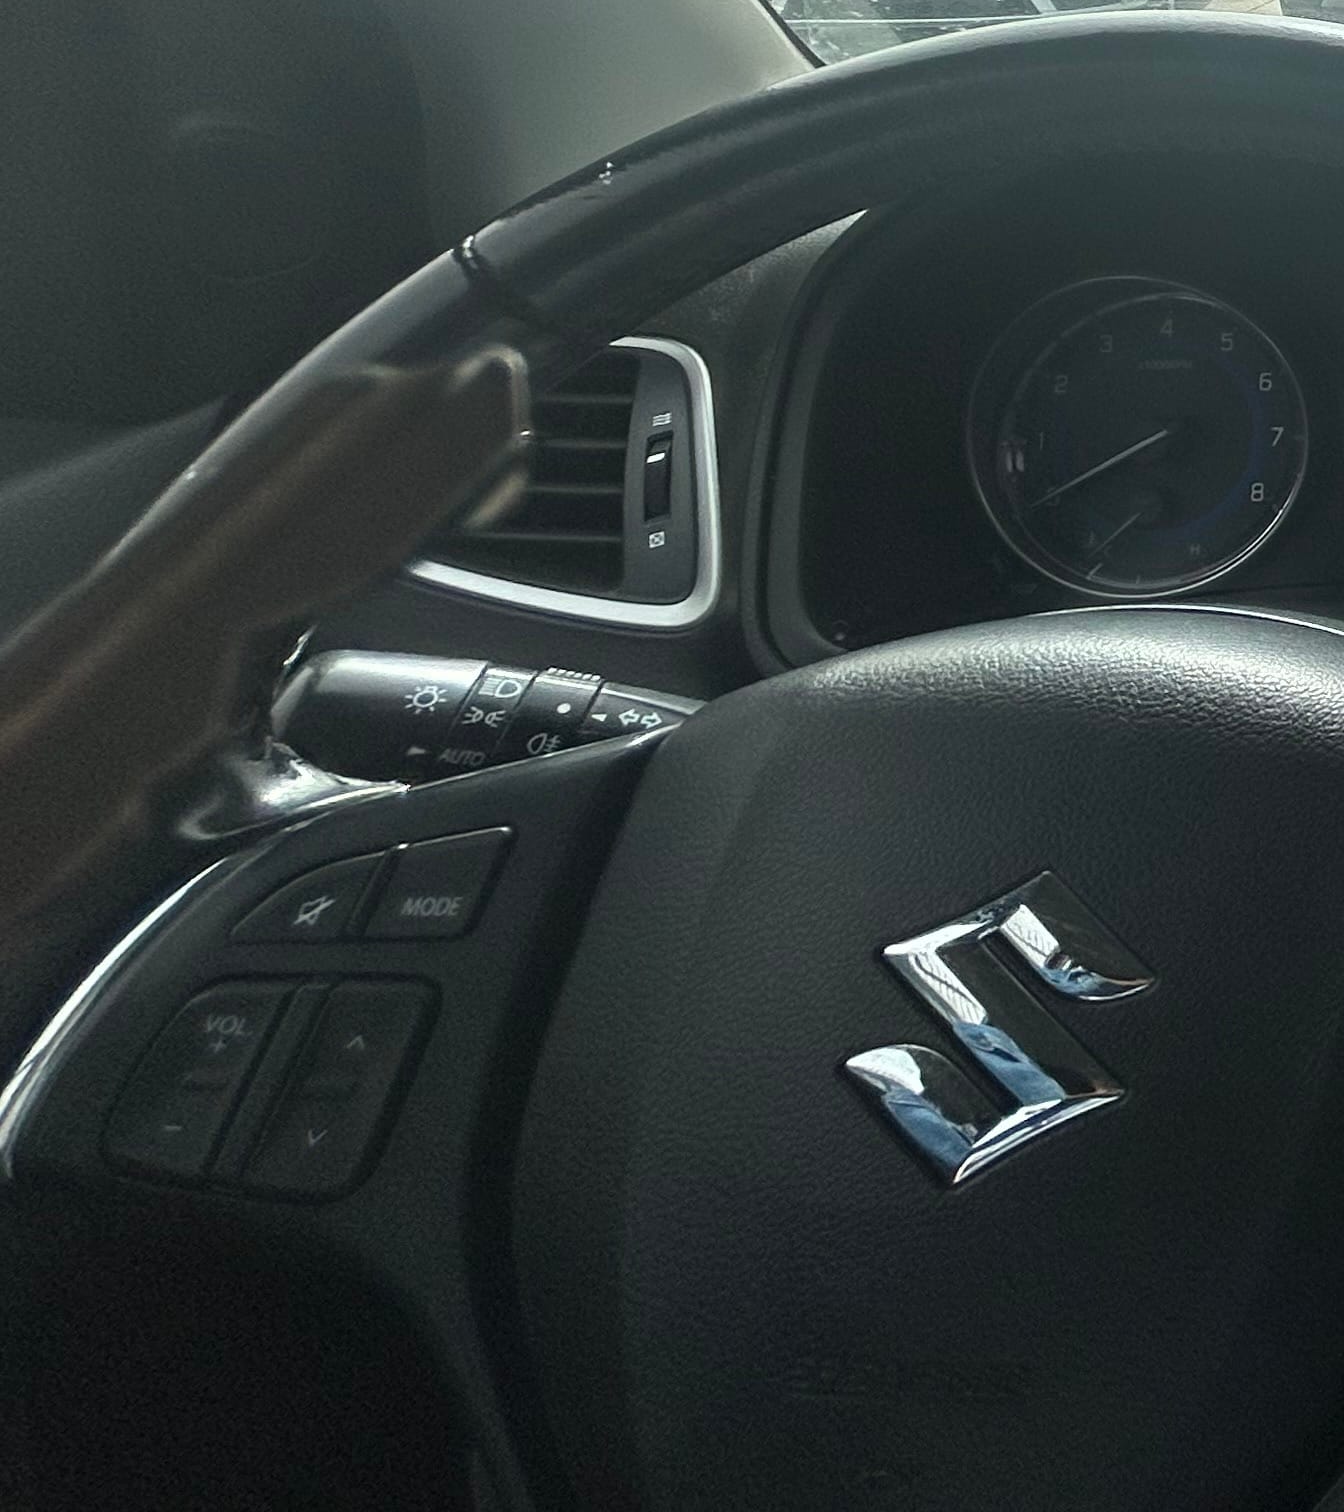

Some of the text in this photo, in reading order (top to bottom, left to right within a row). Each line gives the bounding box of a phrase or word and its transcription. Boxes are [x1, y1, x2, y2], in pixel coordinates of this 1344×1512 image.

[1159, 319, 1174, 337] 4
[1099, 334, 1113, 353] 3
[1220, 333, 1233, 352] 5
[1054, 375, 1069, 394] 2
[1258, 372, 1273, 391] 6
[1270, 426, 1285, 447] 7
[1250, 482, 1265, 502] 8
[439, 748, 487, 767] AUTO
[400, 895, 463, 917] MODE
